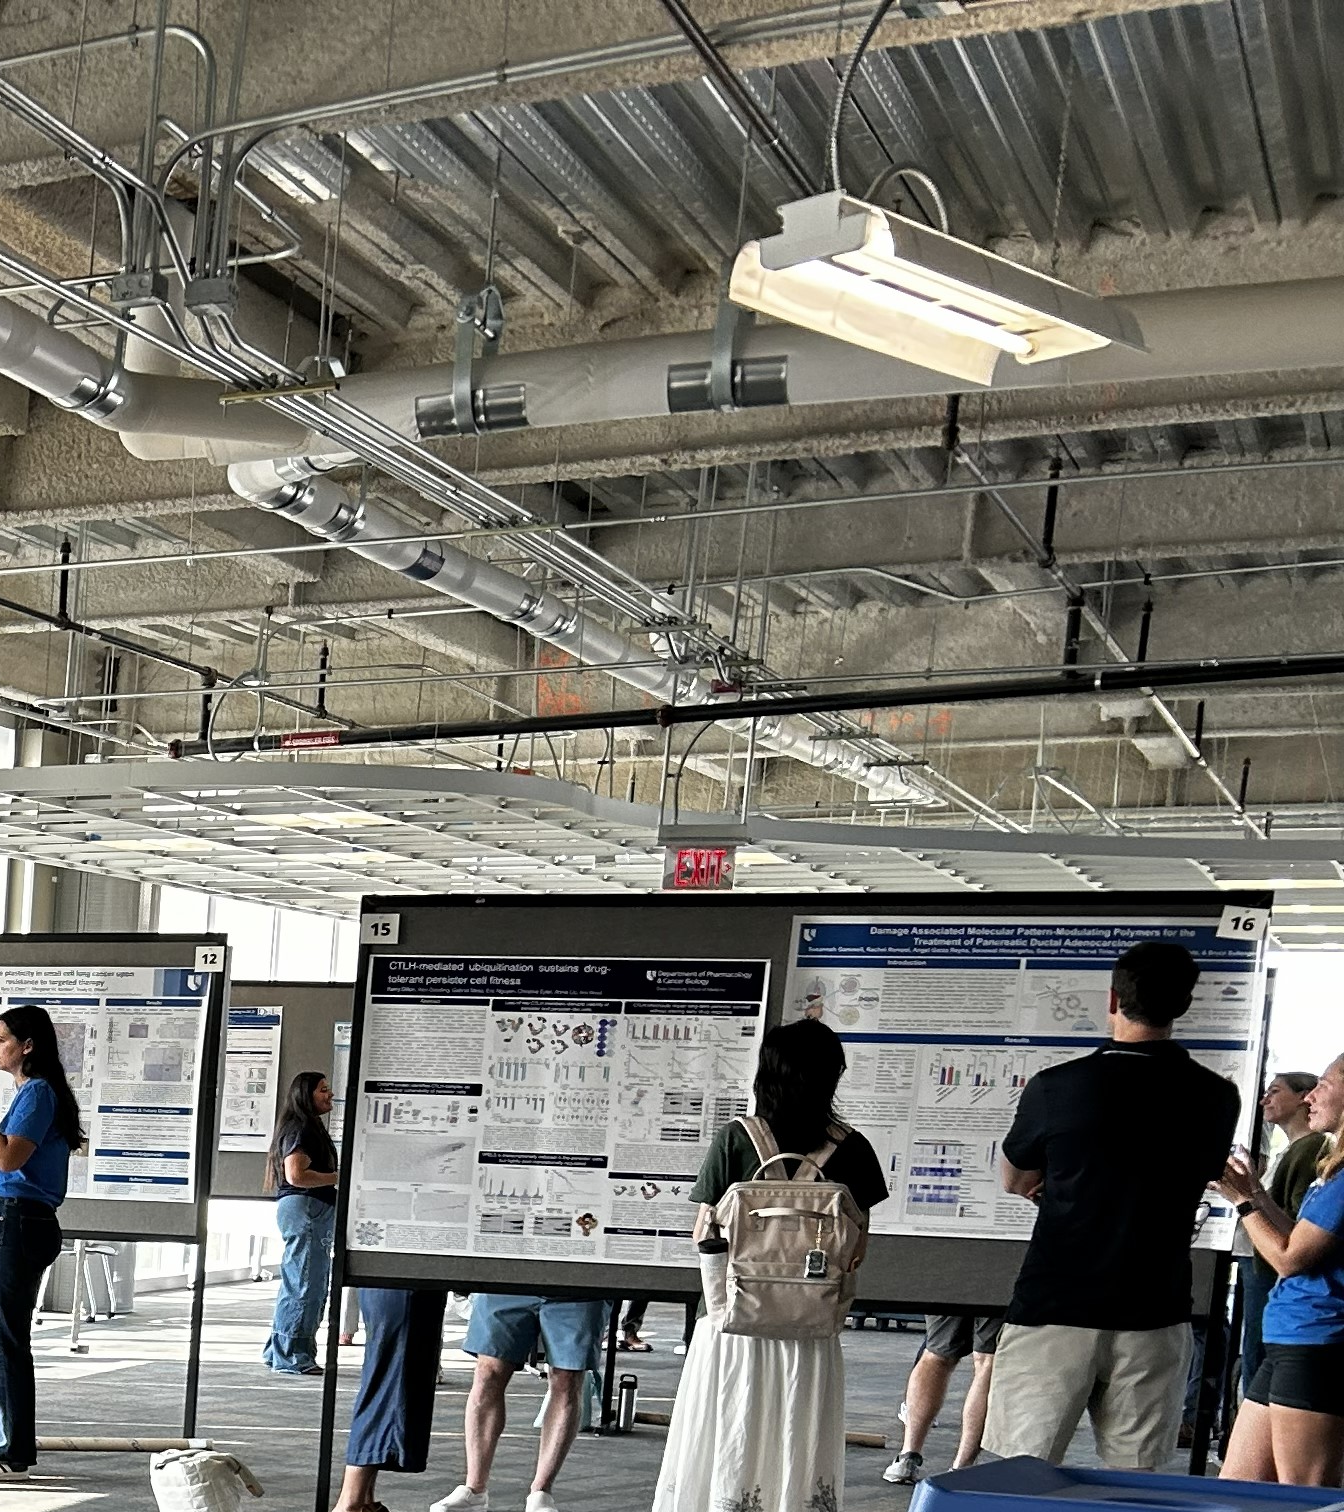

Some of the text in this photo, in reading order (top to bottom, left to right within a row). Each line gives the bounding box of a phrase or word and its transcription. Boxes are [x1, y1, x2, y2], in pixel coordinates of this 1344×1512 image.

[674, 849, 727, 887] EXIT
[370, 922, 391, 937] 15
[870, 926, 909, 937] Damage
[911, 926, 965, 936] Associated
[1230, 916, 1256, 932] 16
[201, 953, 217, 965] 12
